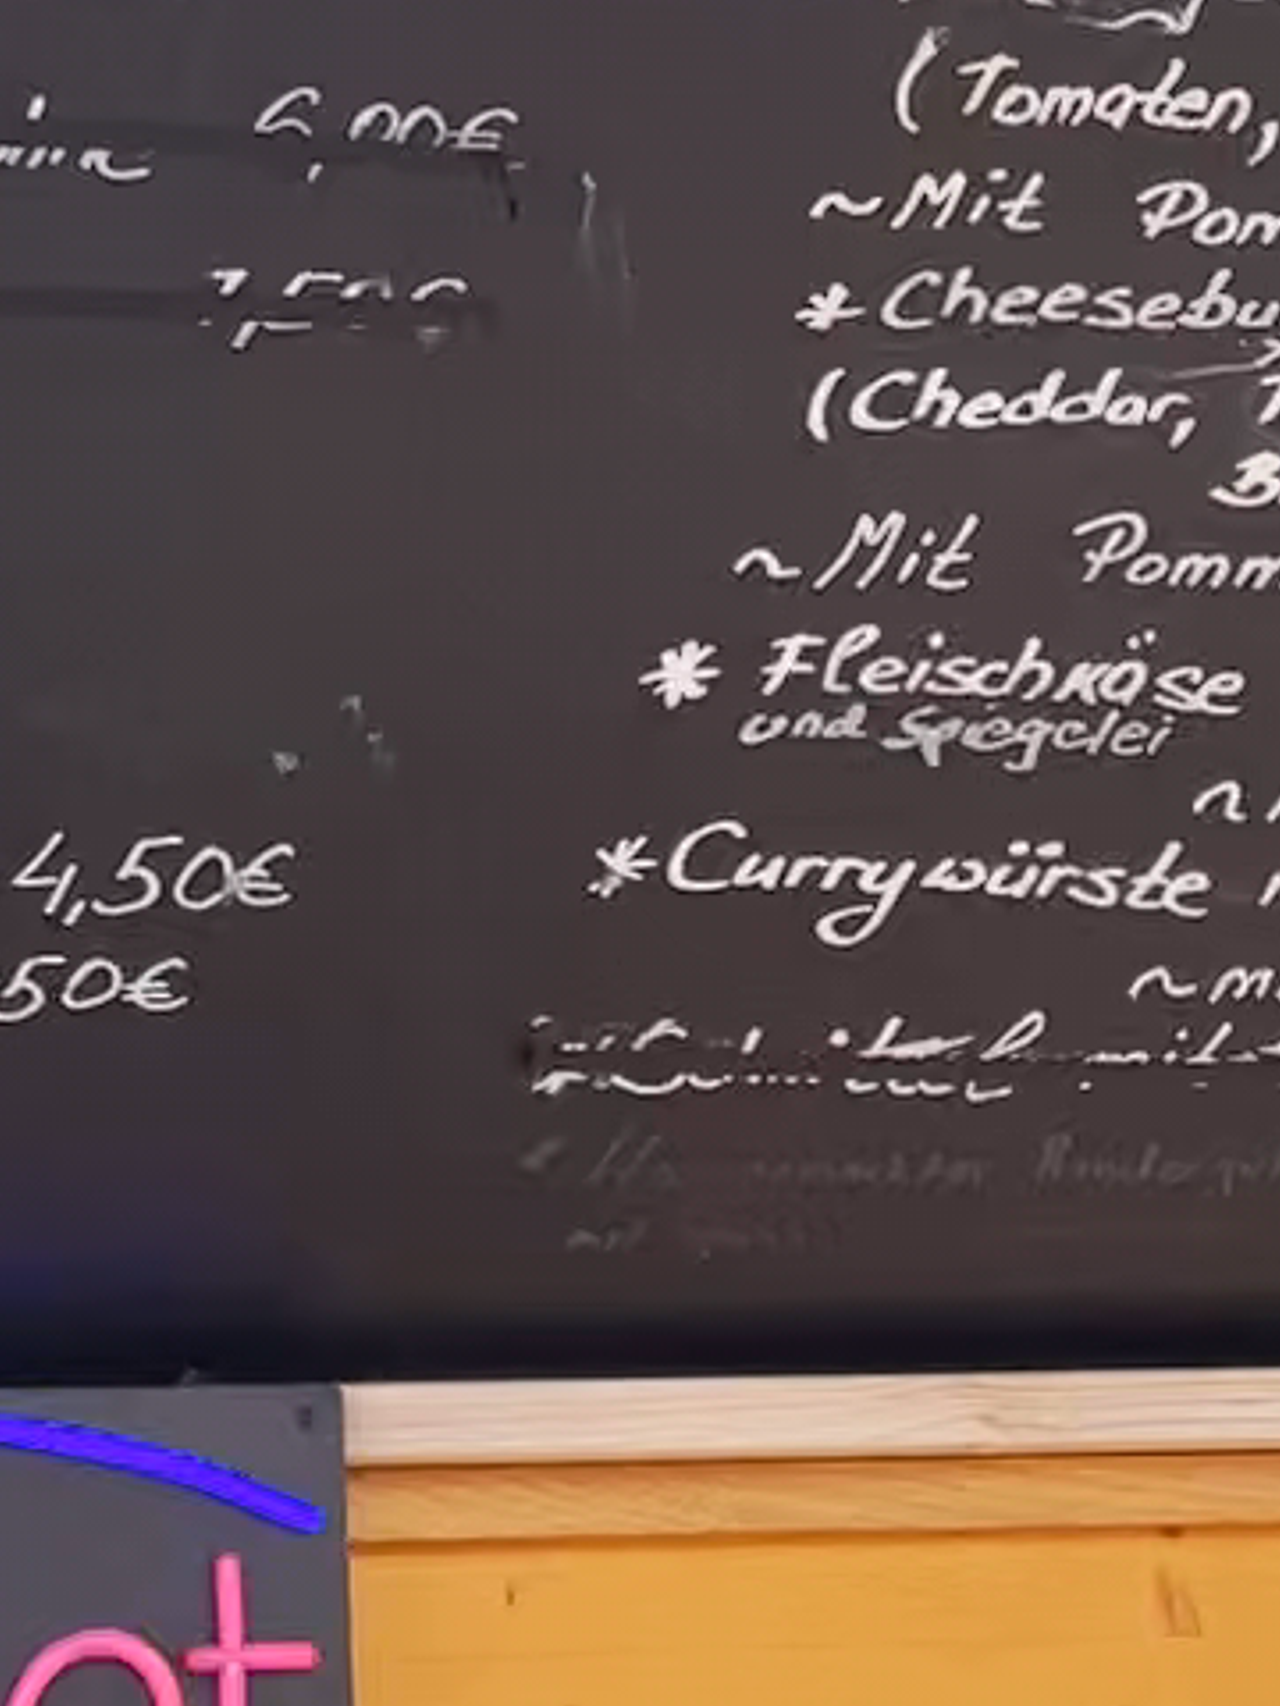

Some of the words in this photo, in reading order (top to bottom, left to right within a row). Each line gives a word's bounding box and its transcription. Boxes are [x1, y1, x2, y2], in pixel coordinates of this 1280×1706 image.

[890, 166, 1050, 234] Mit
[802, 366, 1200, 451] (Cheddar,
[812, 508, 984, 594] Mit
[755, 621, 1250, 718] Fleischkäse
[735, 702, 872, 748] und
[8, 826, 300, 931] 4,50€
[662, 816, 1215, 951] Currywürste
